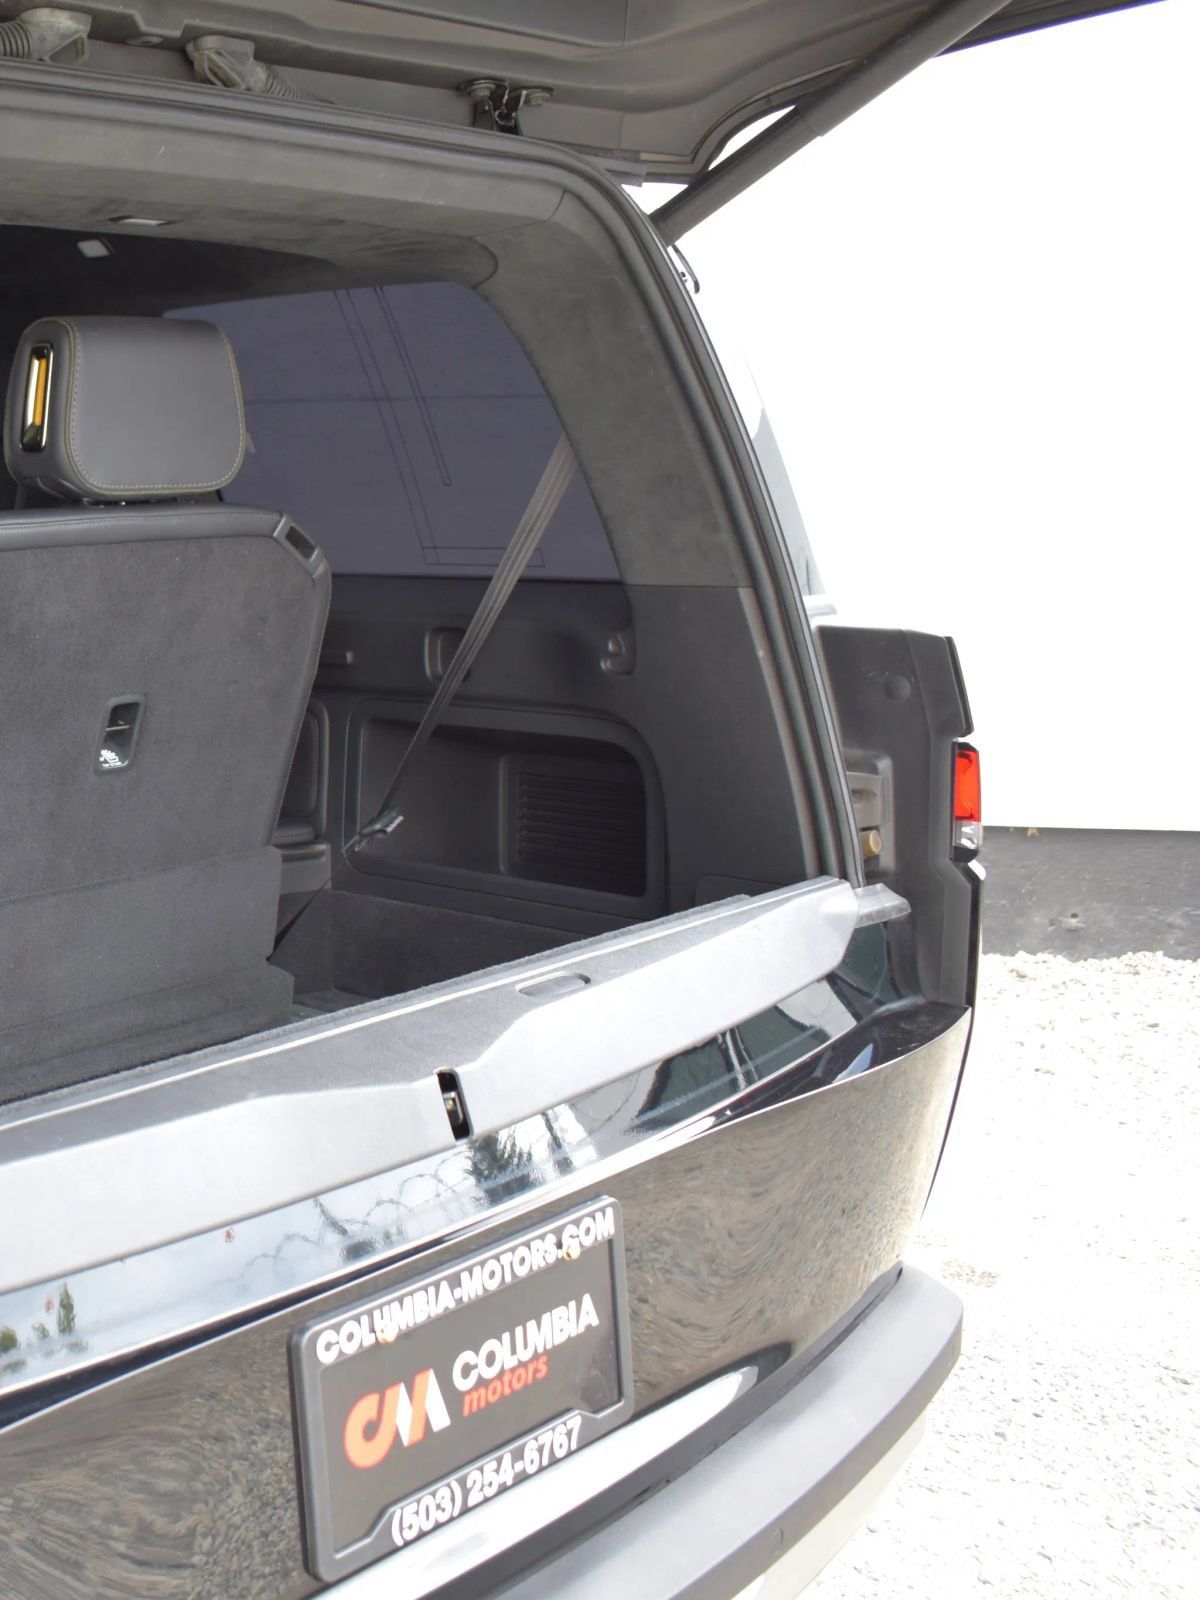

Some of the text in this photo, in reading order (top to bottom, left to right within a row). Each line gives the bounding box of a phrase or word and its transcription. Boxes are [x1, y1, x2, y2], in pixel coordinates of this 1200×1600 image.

[316, 1207, 615, 1364] COLUMBIA-MOTORS.COM
[452, 1293, 599, 1391] COLUMBIA
[462, 1354, 549, 1417] motors
[391, 1416, 582, 1545] (503) 254-6767
